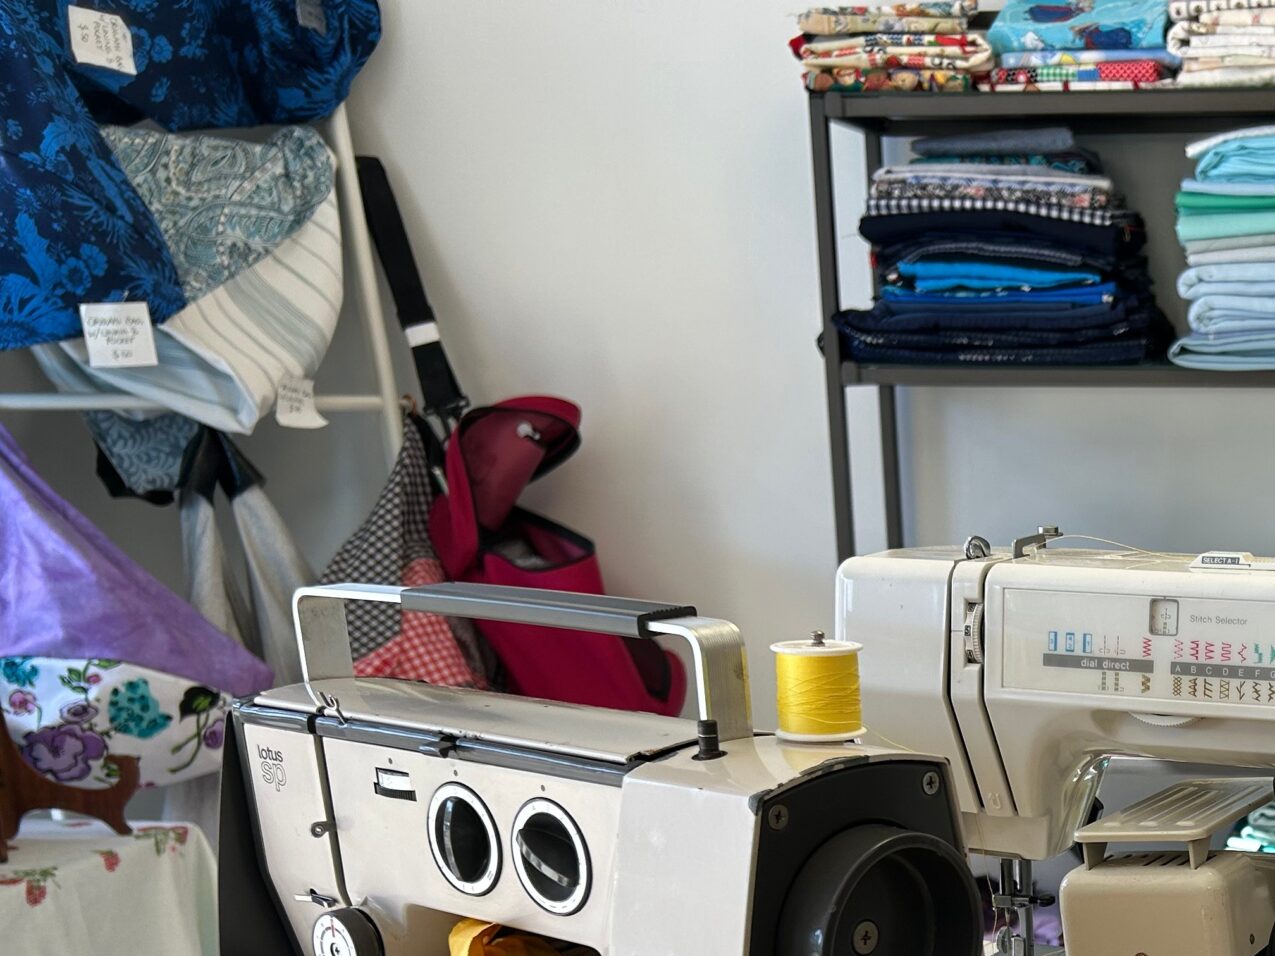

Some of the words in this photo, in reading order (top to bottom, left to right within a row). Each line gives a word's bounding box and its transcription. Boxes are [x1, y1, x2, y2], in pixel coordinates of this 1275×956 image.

[1190, 614, 1213, 624] Stitch
[1215, 616, 1248, 625] Selector
[1080, 658, 1098, 668] dial
[1102, 660, 1130, 670] direct
[257, 744, 283, 762] lotus
[262, 761, 287, 792] sp
